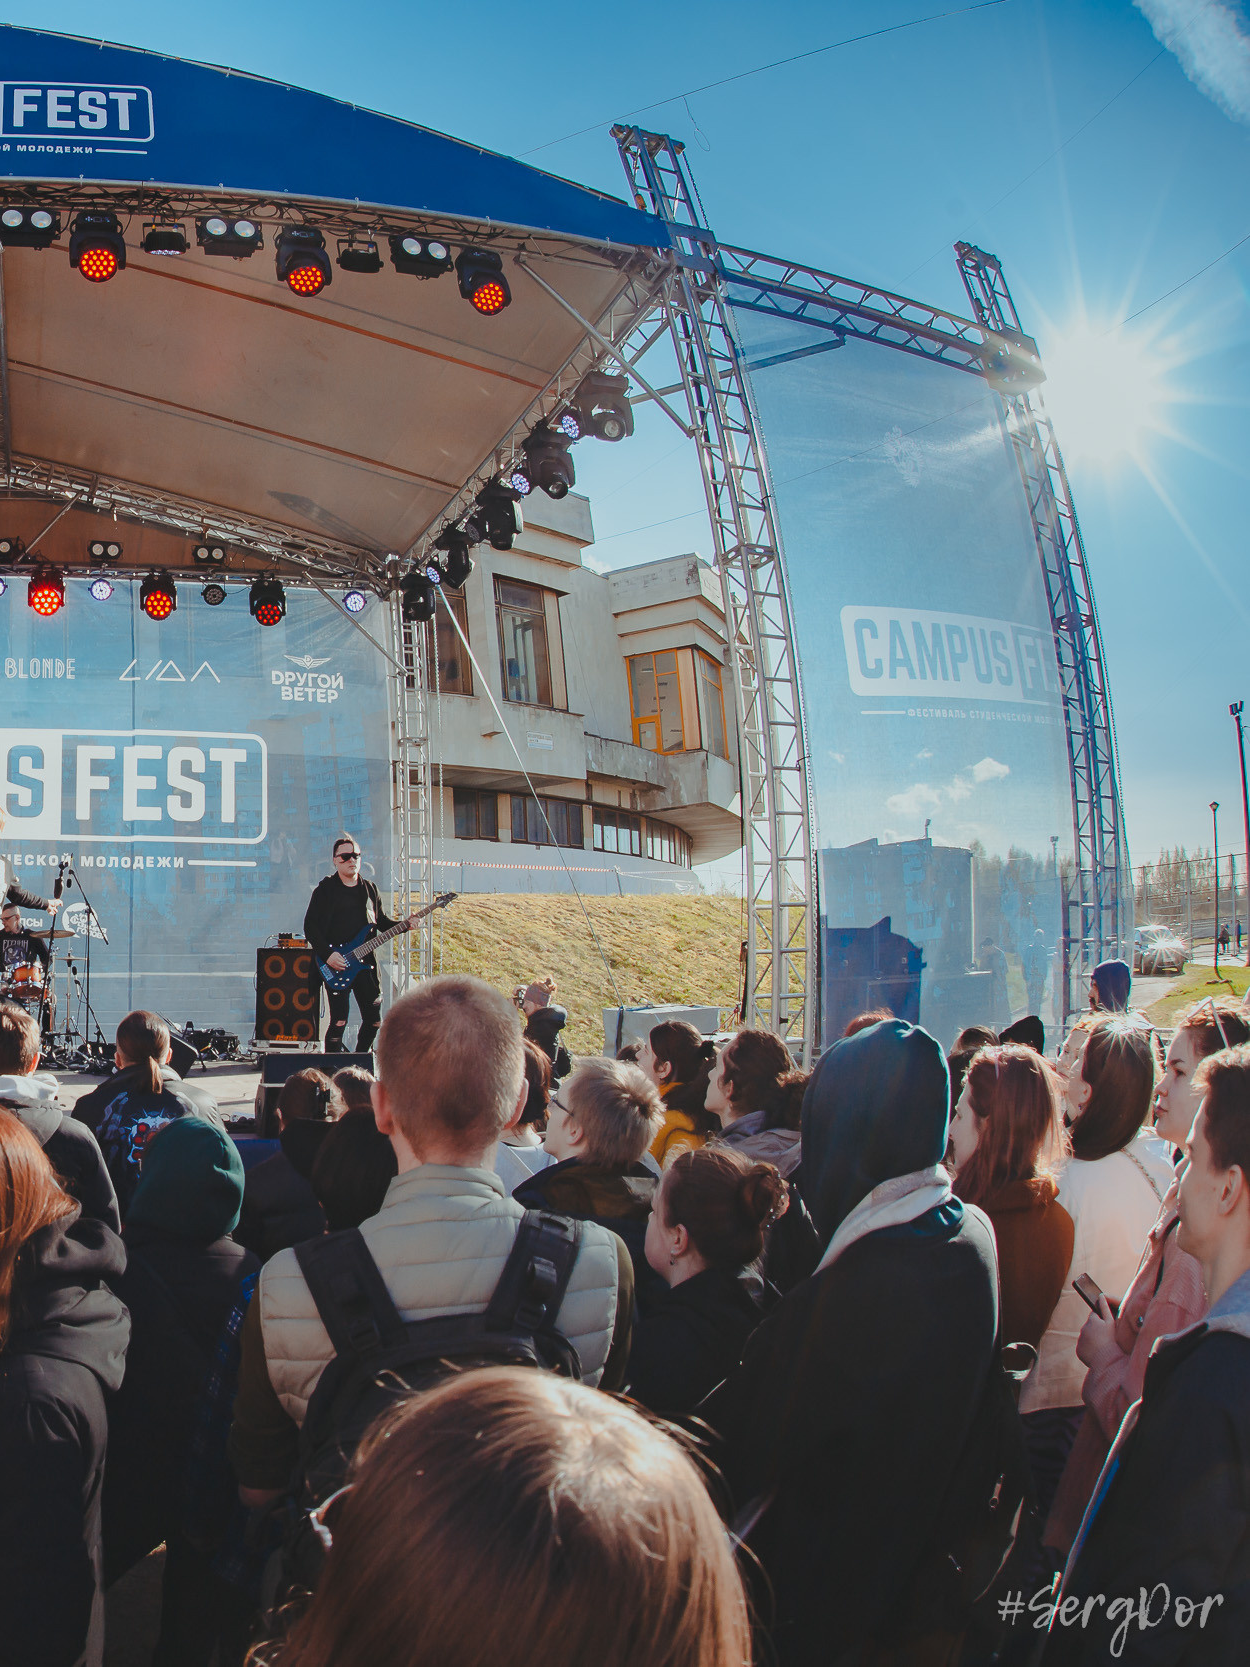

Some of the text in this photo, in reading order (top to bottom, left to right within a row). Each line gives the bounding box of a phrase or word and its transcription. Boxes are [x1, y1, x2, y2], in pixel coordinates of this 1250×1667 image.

[13, 88, 137, 131] FEST
[16, 144, 94, 154] МОЛОДЕЖИ
[853, 618, 1014, 686] CAMPUS
[5, 657, 76, 679] BLONDE
[281, 686, 339, 703] ВЕТЕР
[908, 708, 966, 719] ФЕСТИВАЛЬ
[76, 745, 247, 823] FEST
[80, 854, 184, 870] МОЛОДЕЖИ
